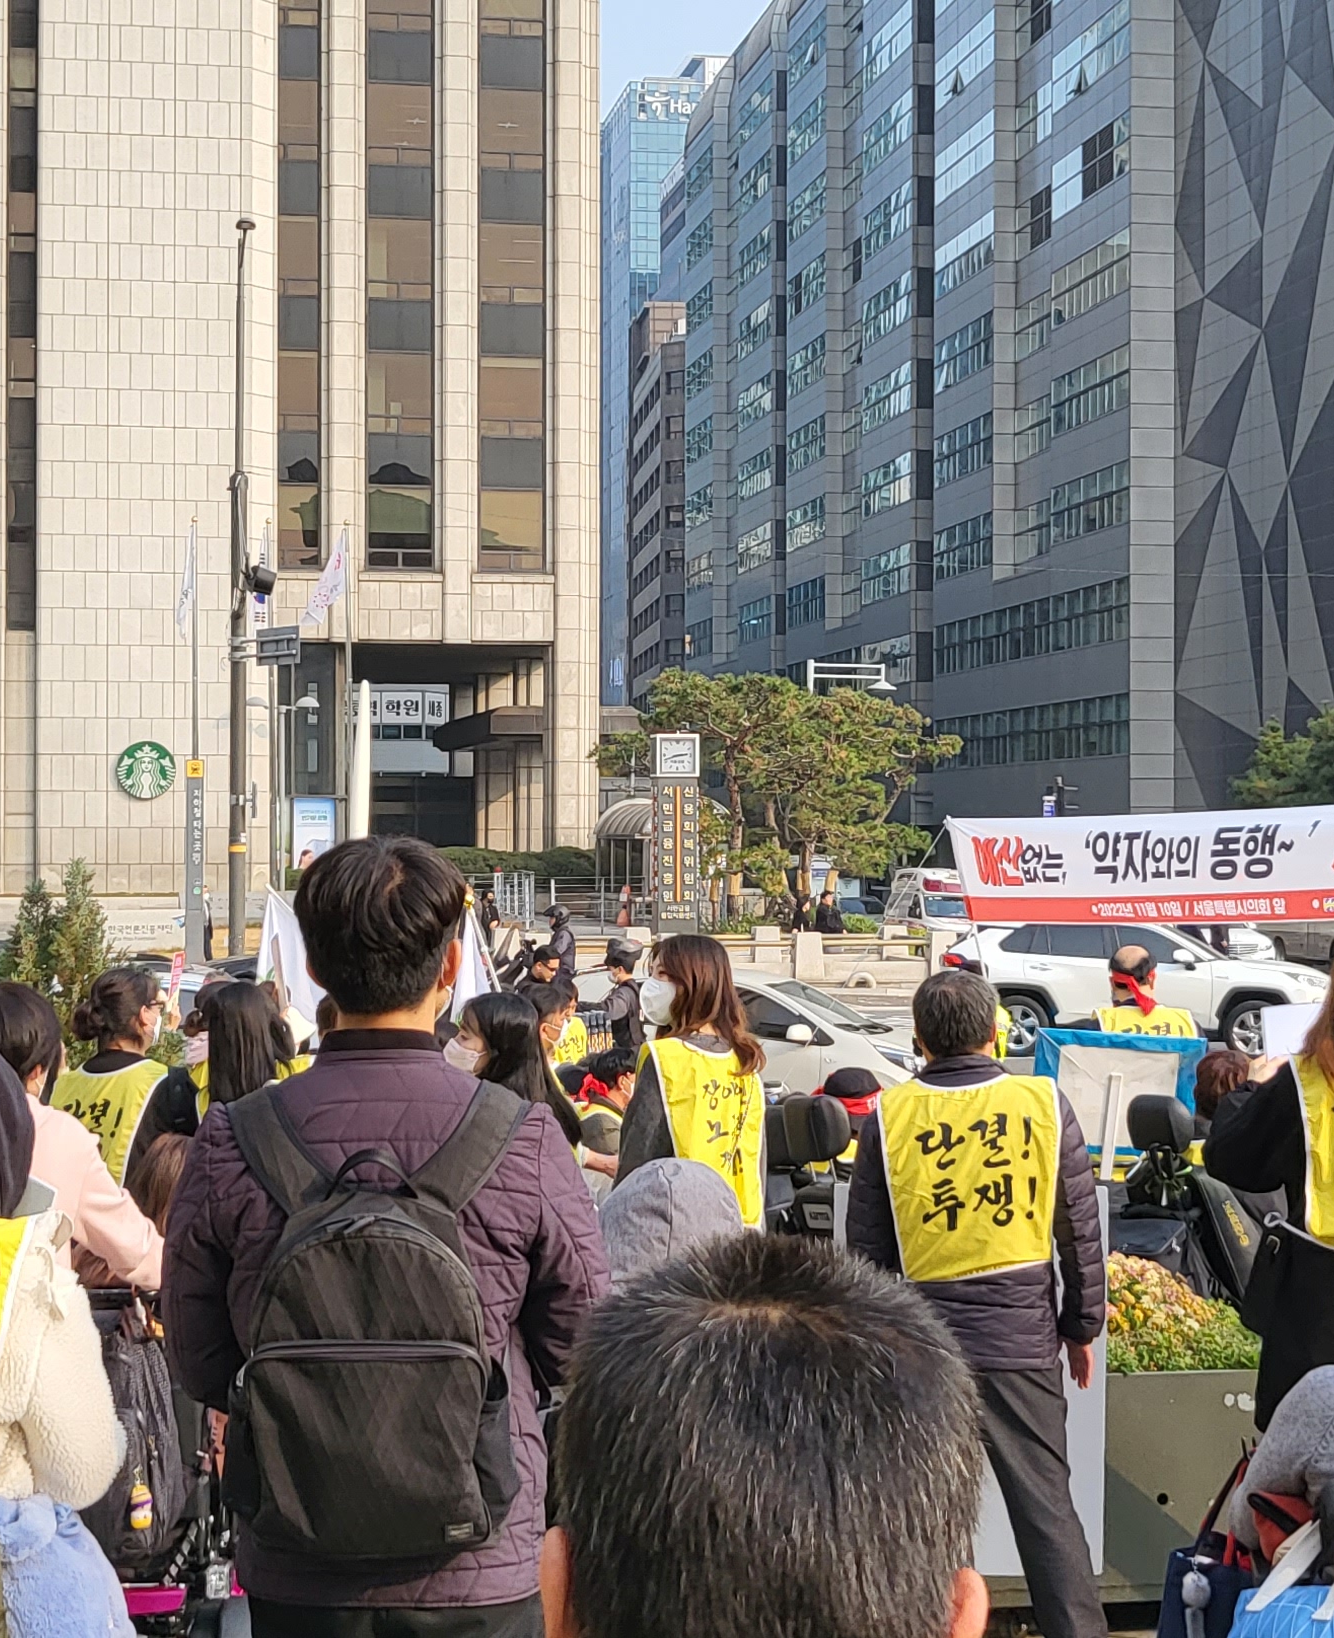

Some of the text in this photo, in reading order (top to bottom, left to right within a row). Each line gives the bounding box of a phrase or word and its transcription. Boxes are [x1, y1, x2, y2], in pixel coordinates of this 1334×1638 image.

[385, 699, 419, 717] 학원
[662, 785, 674, 902] 서민금융진흥원
[683, 785, 695, 902] 신용회복위원회
[107, 924, 173, 935] 한국언론진흥재단
[1098, 902, 1135, 918] 2022년
[1134, 901, 1159, 917] 11월
[1157, 900, 1183, 917] 10일
[1193, 898, 1272, 917] 서울특별시의회
[1273, 897, 1286, 915] 앞
[914, 1112, 1032, 1171] 단결!
[922, 1173, 1037, 1232] 투쟁!
